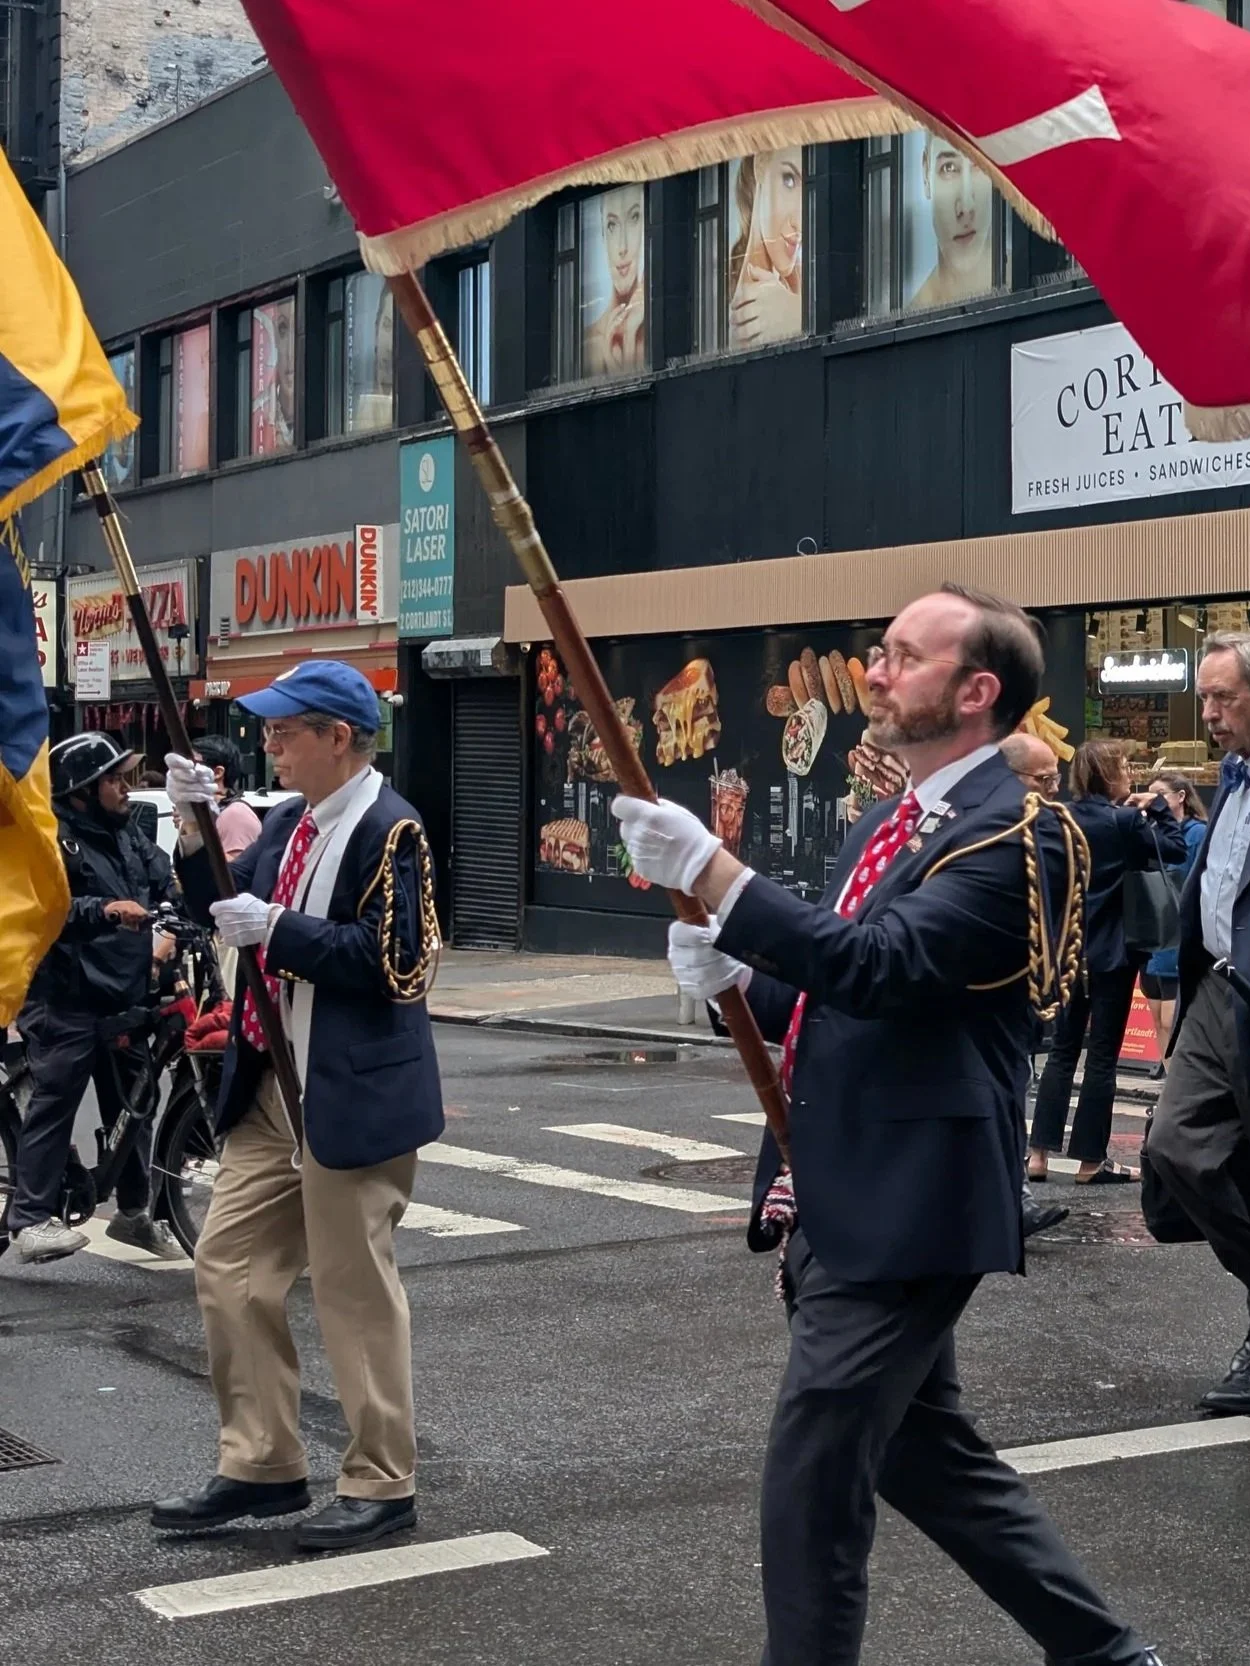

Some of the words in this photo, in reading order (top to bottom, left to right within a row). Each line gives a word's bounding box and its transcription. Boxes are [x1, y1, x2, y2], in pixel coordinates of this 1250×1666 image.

[1102, 401, 1184, 456] EAT
[1028, 477, 1070, 497] FRESH
[1075, 469, 1126, 491] JUICES
[404, 503, 450, 534] SATORI
[405, 534, 447, 564] LASER
[235, 540, 355, 624] DUNKIN
[360, 527, 378, 617] DUNKIN'
[405, 611, 442, 631] CORTLANDT
